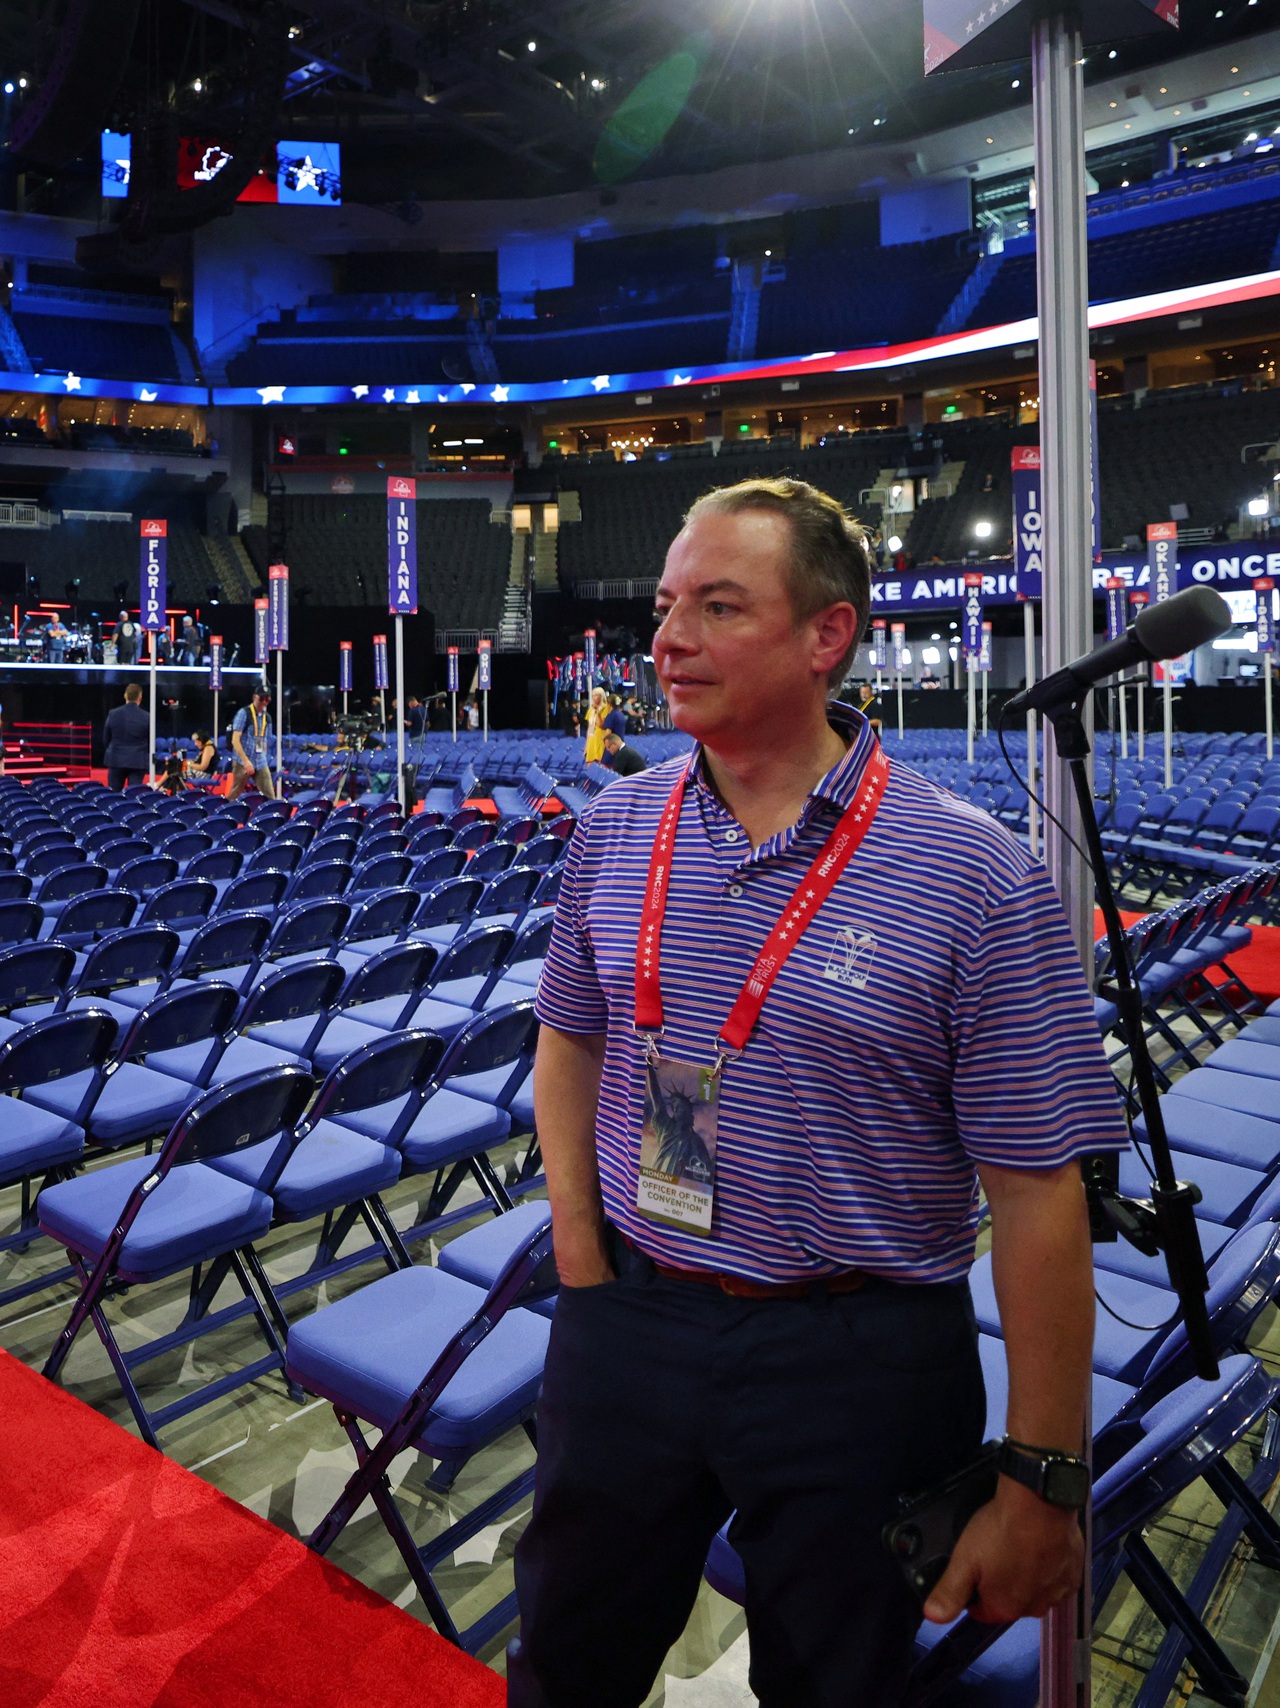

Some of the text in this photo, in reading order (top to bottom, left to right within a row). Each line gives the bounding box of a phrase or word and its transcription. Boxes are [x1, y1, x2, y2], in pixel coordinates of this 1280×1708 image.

[397, 501, 410, 604] INDIANA
[1021, 490, 1042, 573] IOWA
[147, 539, 160, 624] FLORIDA
[870, 582, 902, 602] KE
[1192, 553, 1280, 583] ONCE
[1155, 541, 1170, 602] OKLAHO
[966, 587, 981, 646] HAWAII
[1257, 596, 1269, 643] IDAHO
[481, 653, 489, 683] OHIO
[817, 833, 850, 879] RNC2024
[651, 866, 665, 910] RNC2024
[752, 957, 767, 982] DATA
[758, 954, 778, 983] TRUST
[837, 974, 853, 985] RUN
[703, 1084, 710, 1100] 1
[642, 1168, 674, 1182] MONDAY
[642, 1180, 677, 1196] OFFICER
[678, 1191, 690, 1201] OF
[693, 1194, 709, 1207] THE
[647, 1191, 702, 1214] CONVENTION
